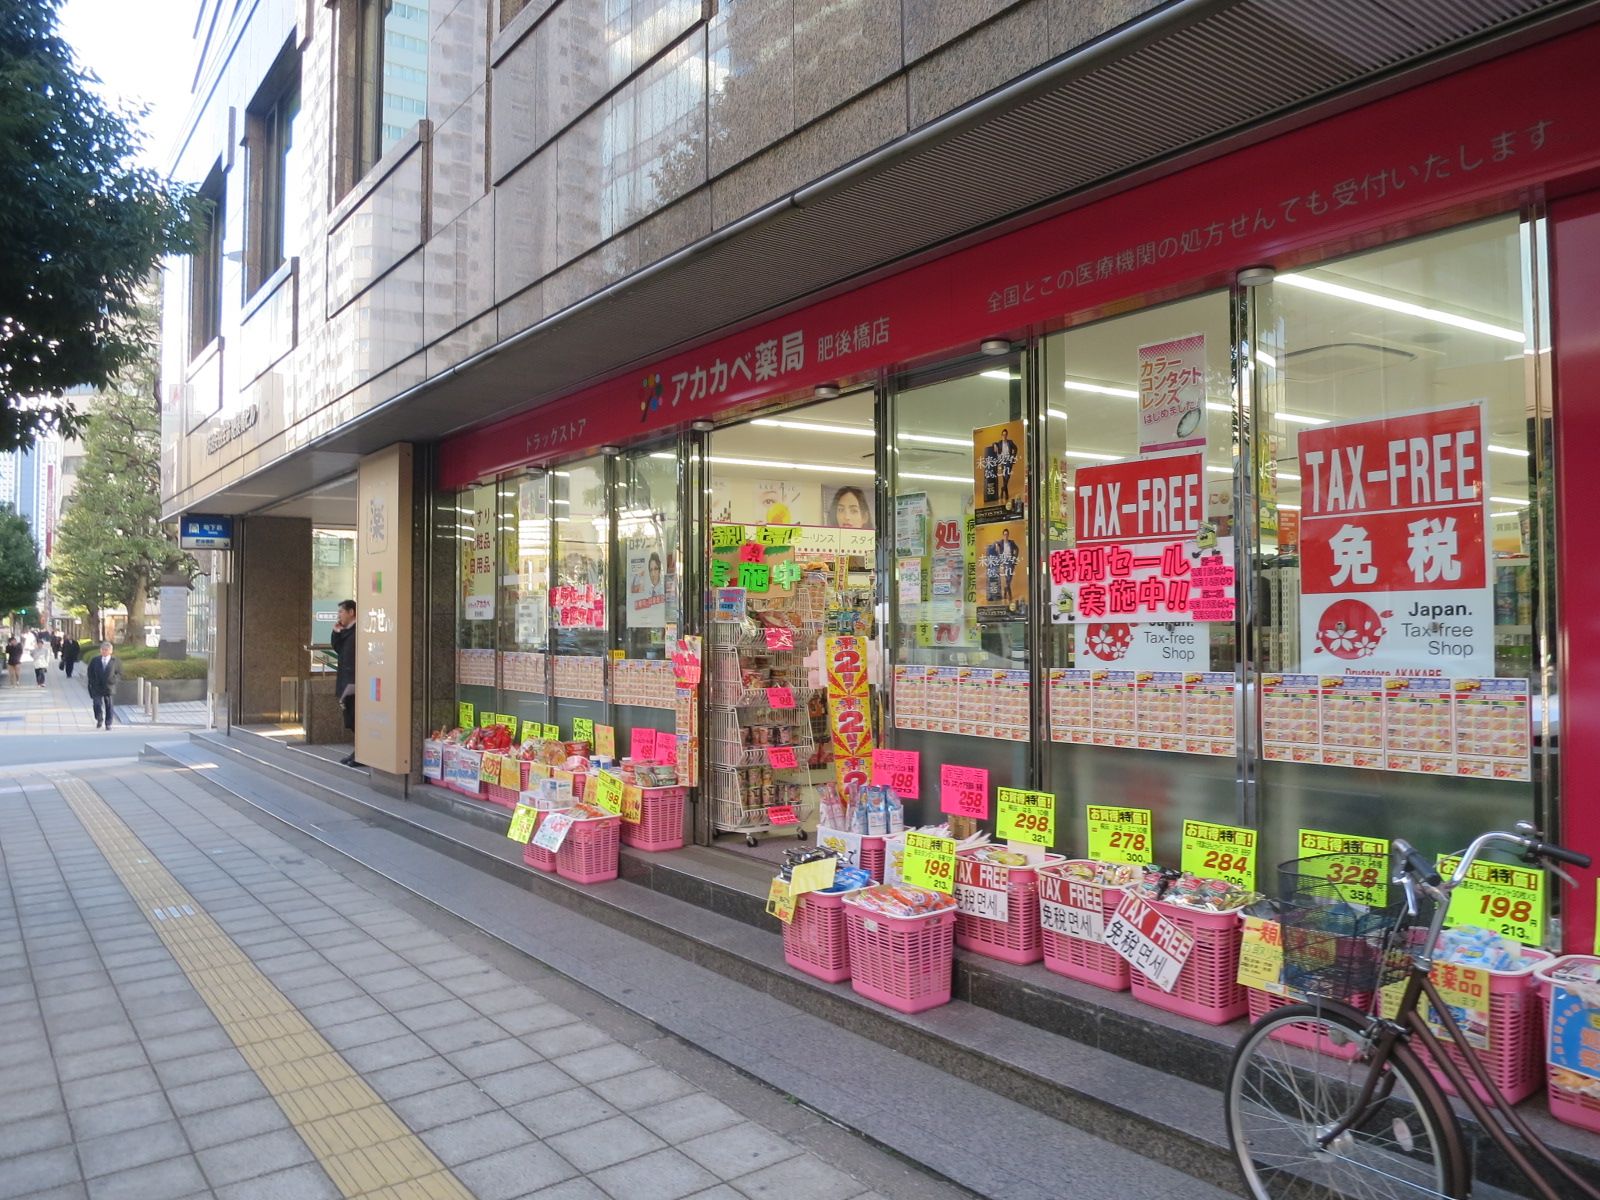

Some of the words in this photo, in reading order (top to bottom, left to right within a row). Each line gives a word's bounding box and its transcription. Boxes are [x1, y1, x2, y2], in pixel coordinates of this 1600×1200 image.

[671, 329, 804, 407] アカカベ薬局
[817, 316, 890, 362] 肥後橋店
[1141, 356, 1182, 377] カラー
[1141, 366, 1202, 392] コンタクト
[1142, 388, 1181, 409] レンズ
[1305, 430, 1477, 514] TAX-FREE
[1079, 474, 1199, 538] TAX-FREE
[1328, 516, 1463, 588] 免税
[1051, 543, 1191, 584] 特別セール
[1079, 576, 1191, 617] 実施中!!
[1408, 601, 1473, 620] Japan.
[1143, 631, 1195, 645] Tax-free
[1401, 622, 1474, 638] Tax-free
[1162, 646, 1196, 662] Shop
[1427, 641, 1475, 658] Shop
[834, 650, 861, 673] 2
[838, 710, 864, 733] 2
[891, 772, 914, 788] 198
[959, 790, 983, 808] 258
[1014, 813, 1049, 833] 298
[1032, 833, 1047, 842] 321
[1109, 831, 1146, 851] 278
[1126, 853, 1143, 862] 300
[1203, 850, 1248, 875] 284
[924, 859, 950, 879] 198
[979, 866, 1009, 891] FREE
[1327, 863, 1379, 888] 328
[933, 879, 947, 890] 213
[1039, 875, 1062, 903] TAX
[1069, 882, 1102, 911] FREE
[1480, 895, 1532, 922] 198
[1118, 895, 1147, 929] TAX
[1150, 920, 1194, 960] FREE
[1501, 924, 1526, 939] 213
